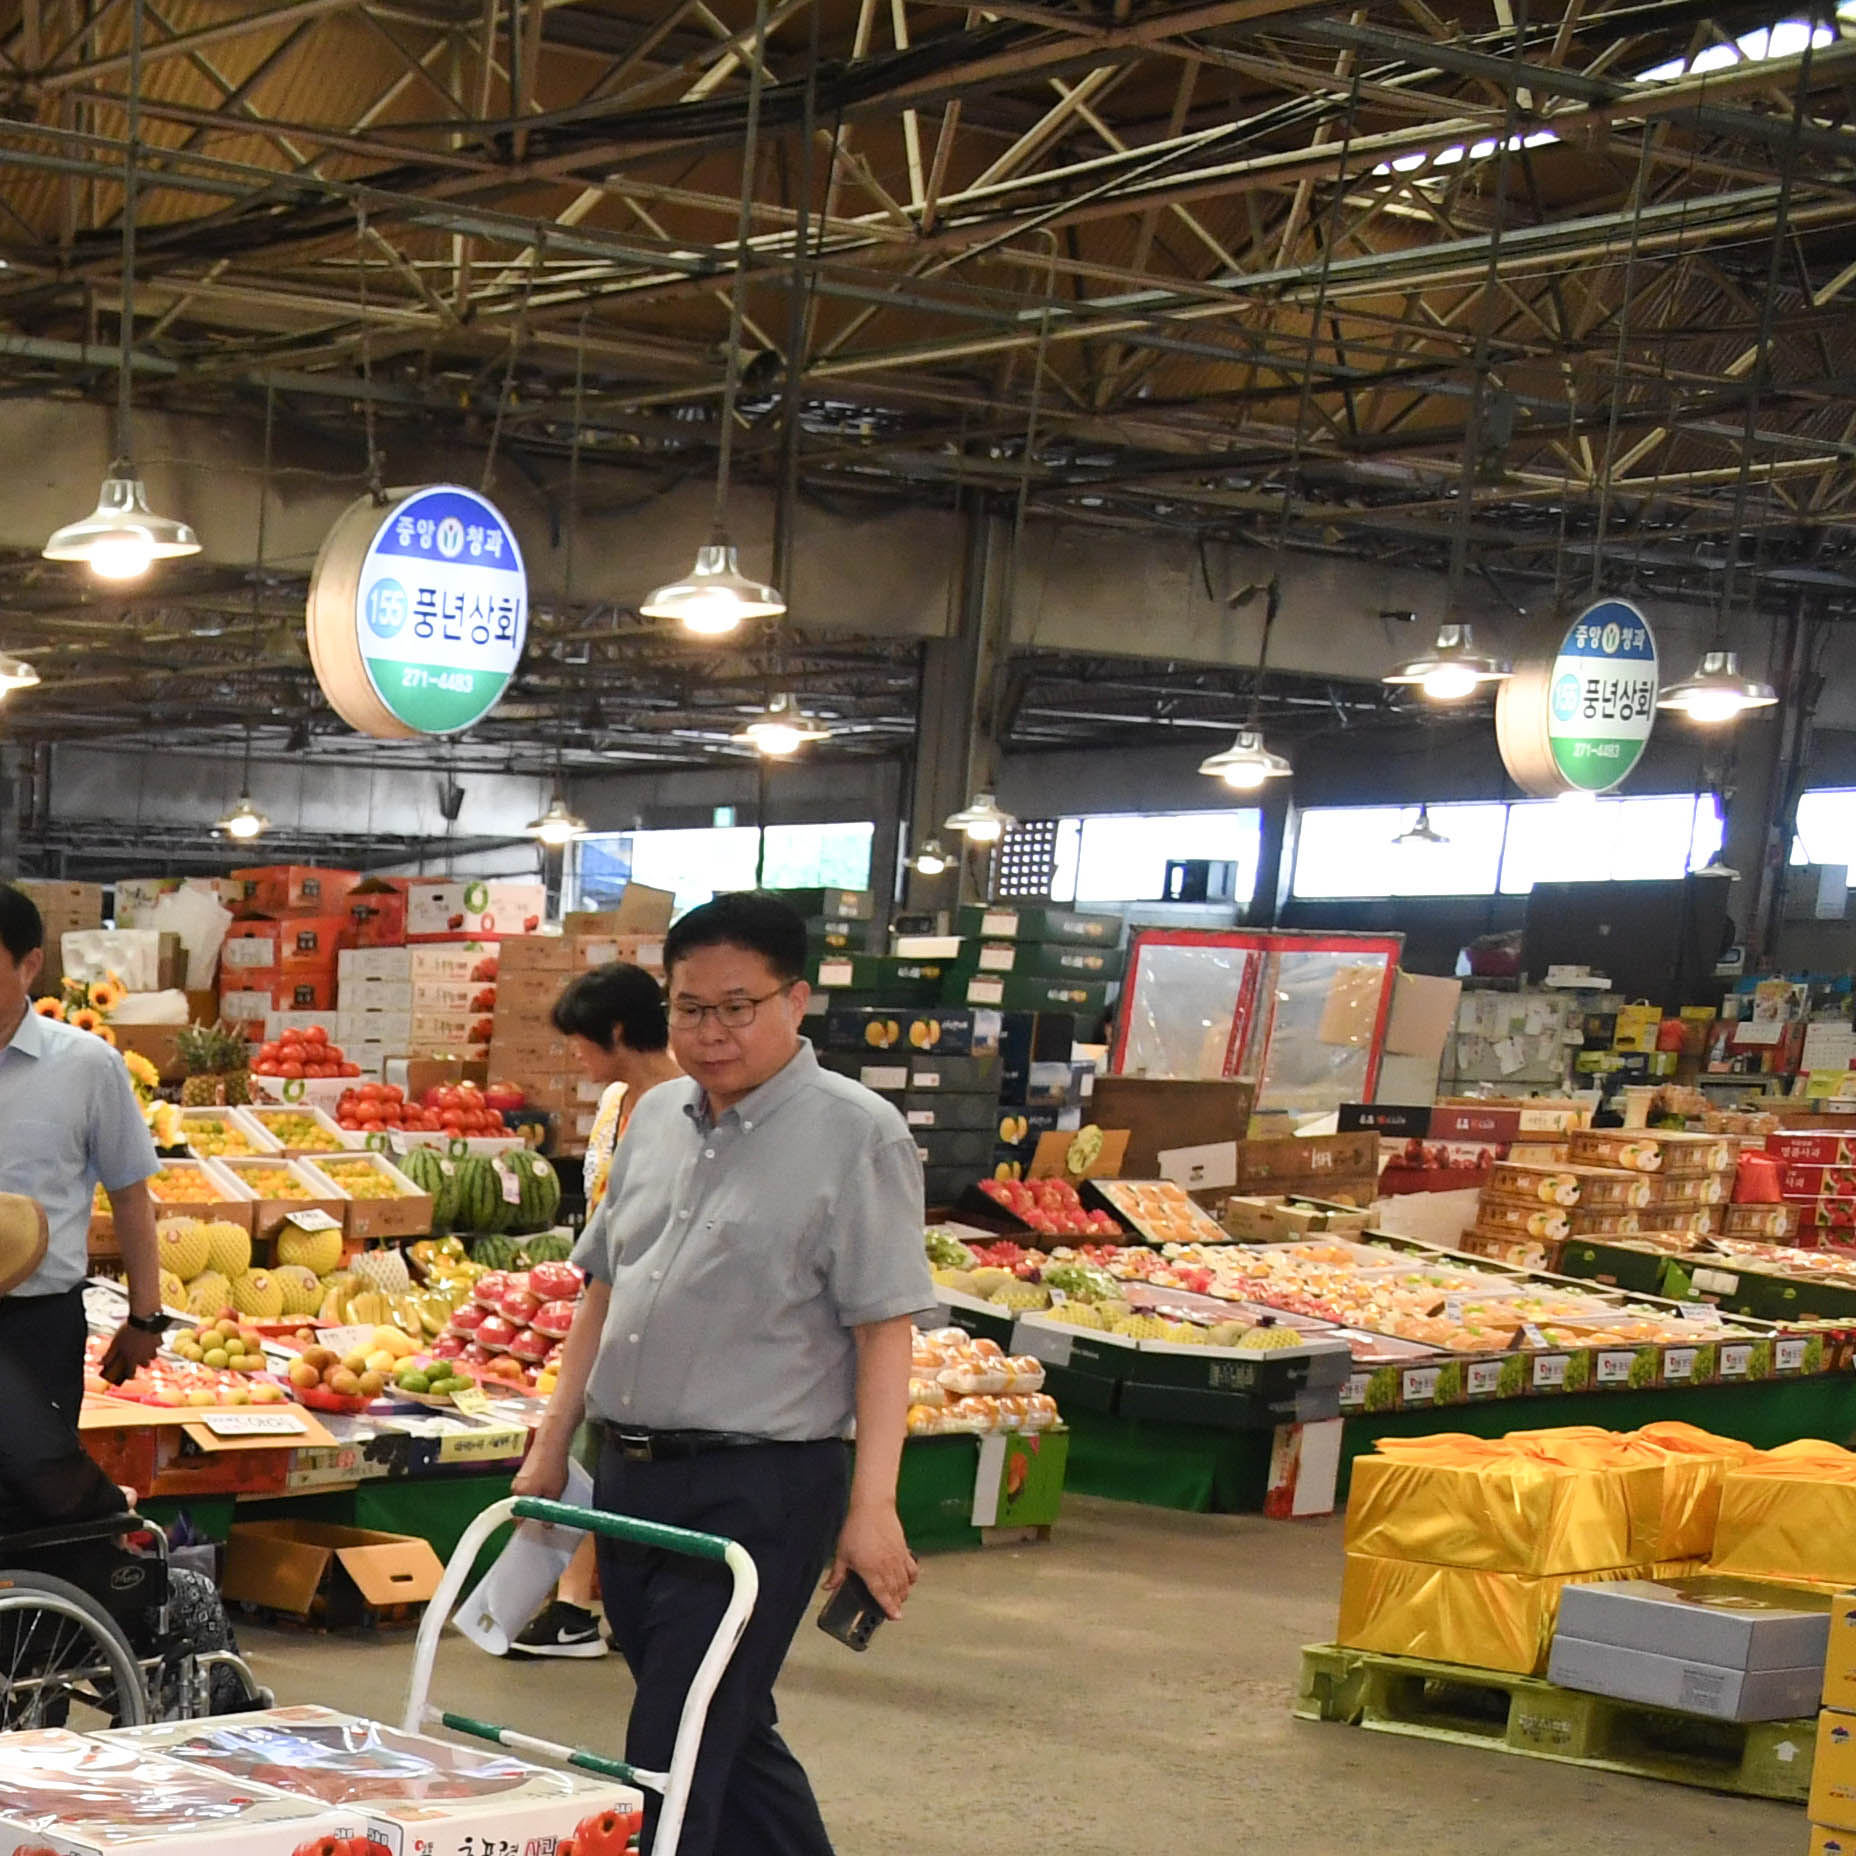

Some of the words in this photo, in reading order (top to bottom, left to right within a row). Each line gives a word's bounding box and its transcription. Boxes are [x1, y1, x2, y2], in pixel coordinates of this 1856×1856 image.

[396, 516, 435, 549] 중앙
[466, 525, 504, 558] 청과
[414, 588, 520, 649] 풍년상회
[1576, 625, 1602, 649] 중앙
[1621, 628, 1646, 650] 청과
[1583, 679, 1654, 721] 풍년상회
